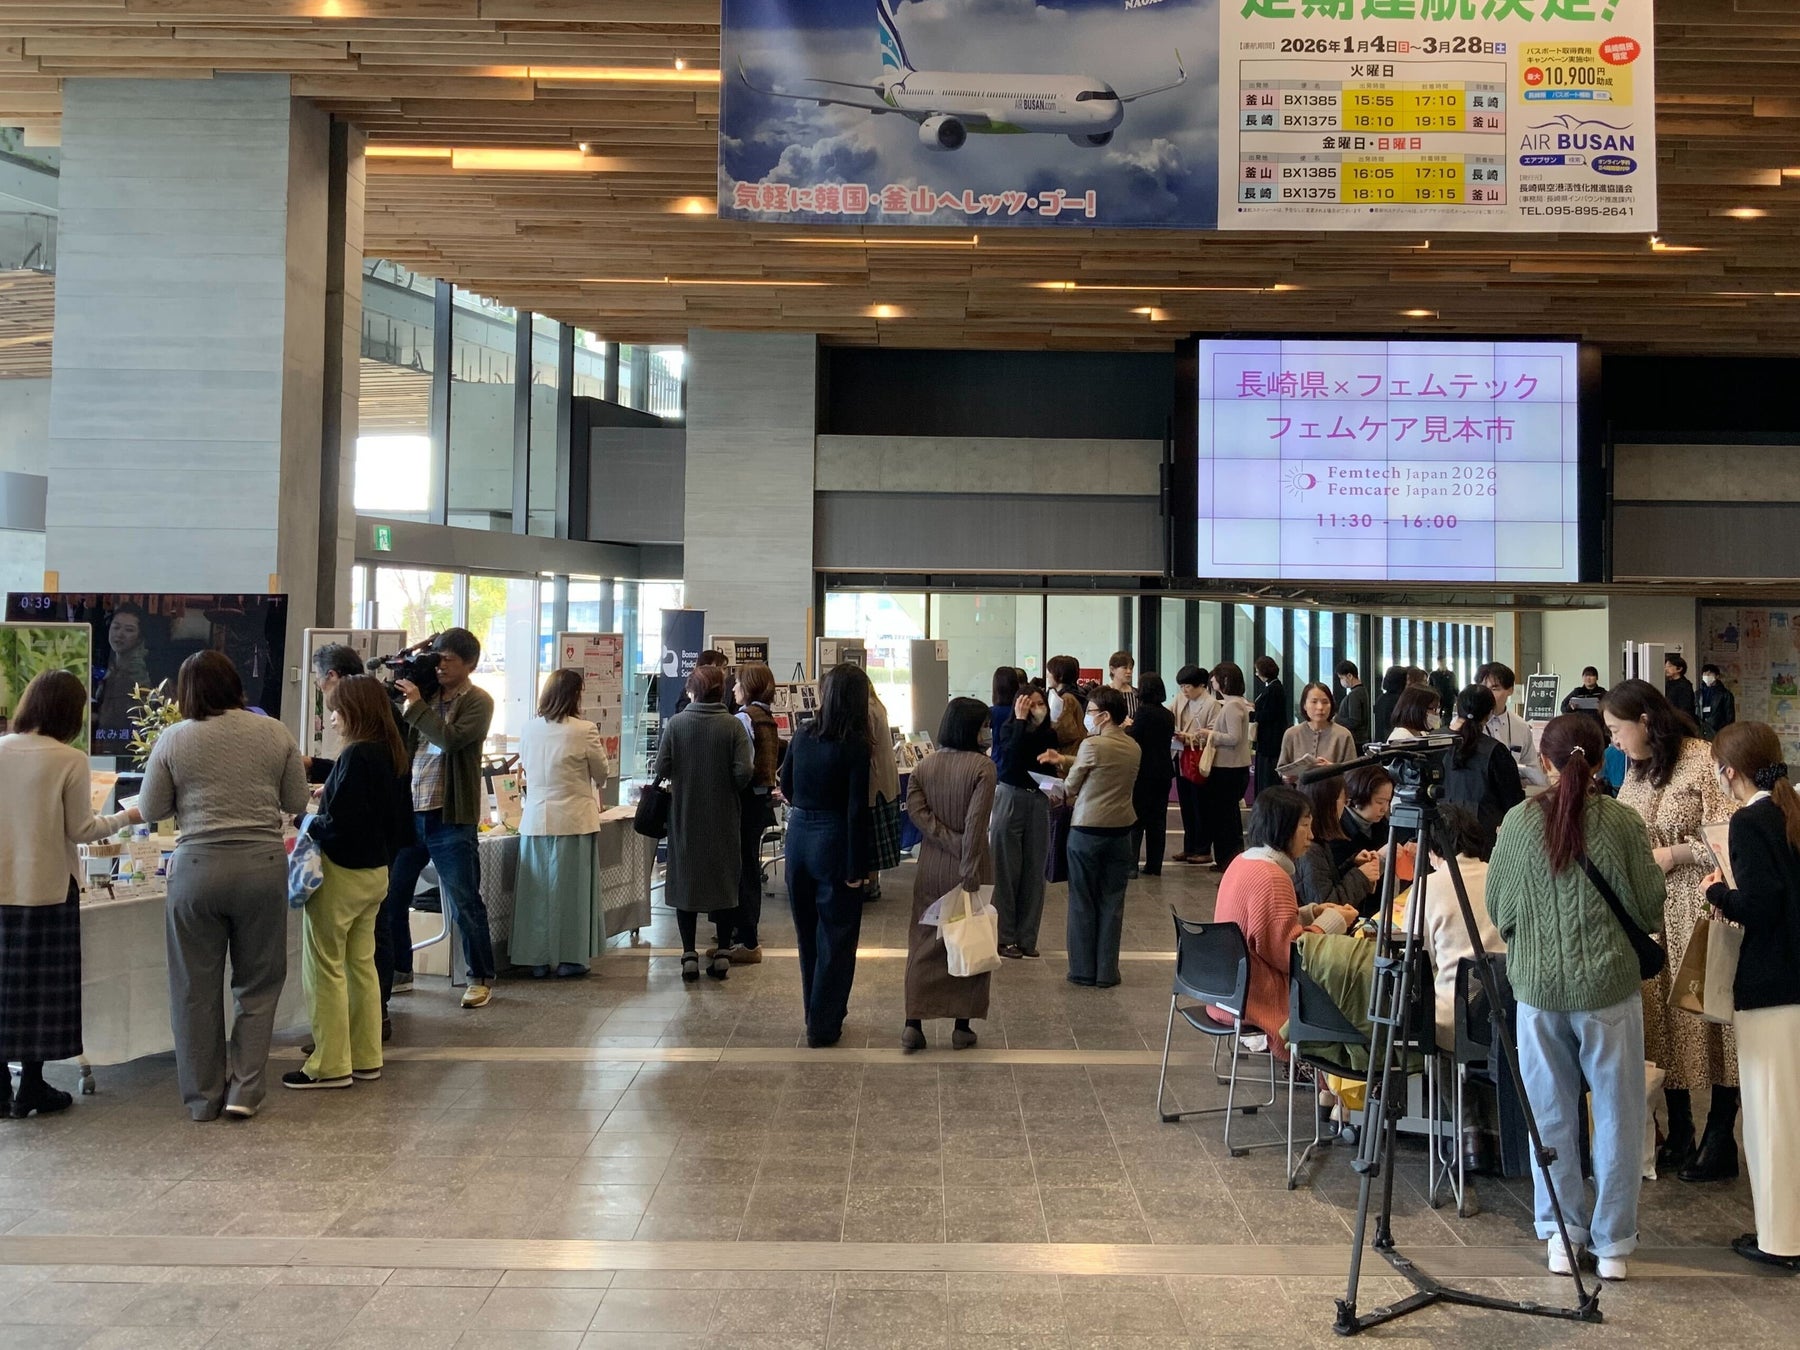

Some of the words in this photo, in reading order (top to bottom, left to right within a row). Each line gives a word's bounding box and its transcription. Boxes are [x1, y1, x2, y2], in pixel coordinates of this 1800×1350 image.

[1351, 64, 1394, 77] 火曜日
[1545, 67, 1595, 86] 10,900
[1597, 67, 1605, 76] 円
[1246, 94, 1273, 106] 釜山
[1284, 95, 1337, 106] BX1385
[1354, 95, 1394, 106] 15:55
[1415, 96, 1456, 106] 17:10
[1472, 96, 1499, 108] 長崎
[1246, 114, 1273, 126] 長崎
[1284, 115, 1337, 126] BX1375
[1354, 115, 1394, 126] 18:10
[1415, 116, 1456, 127] 19:15
[1472, 116, 1499, 129] 釜山
[1520, 134, 1551, 150] AIR
[1557, 133, 1635, 151] BUSAN
[1245, 167, 1272, 179] 釜山
[1283, 168, 1337, 178] BX1385
[1354, 168, 1394, 179] 16:05
[1416, 168, 1456, 178] 17:10
[1472, 169, 1498, 181] 長崎
[1245, 187, 1272, 199] 長崎
[1283, 188, 1336, 198] BX1375
[1353, 189, 1394, 199] 18:10
[1416, 188, 1456, 198] 19:15
[1472, 190, 1498, 201] 釜山
[1519, 206, 1634, 217] TEL.095-895-2641
[1266, 415, 1516, 443] フェムケア見本市
[1328, 466, 1400, 479] Femtech
[1406, 468, 1448, 482] Japan
[1452, 466, 1497, 479] 2026
[1328, 483, 1400, 496] Femcare
[1406, 484, 1448, 498] Japan
[1452, 483, 1497, 496] 2026
[1317, 513, 1372, 527] 11:30
[1402, 514, 1457, 528] 16:00
